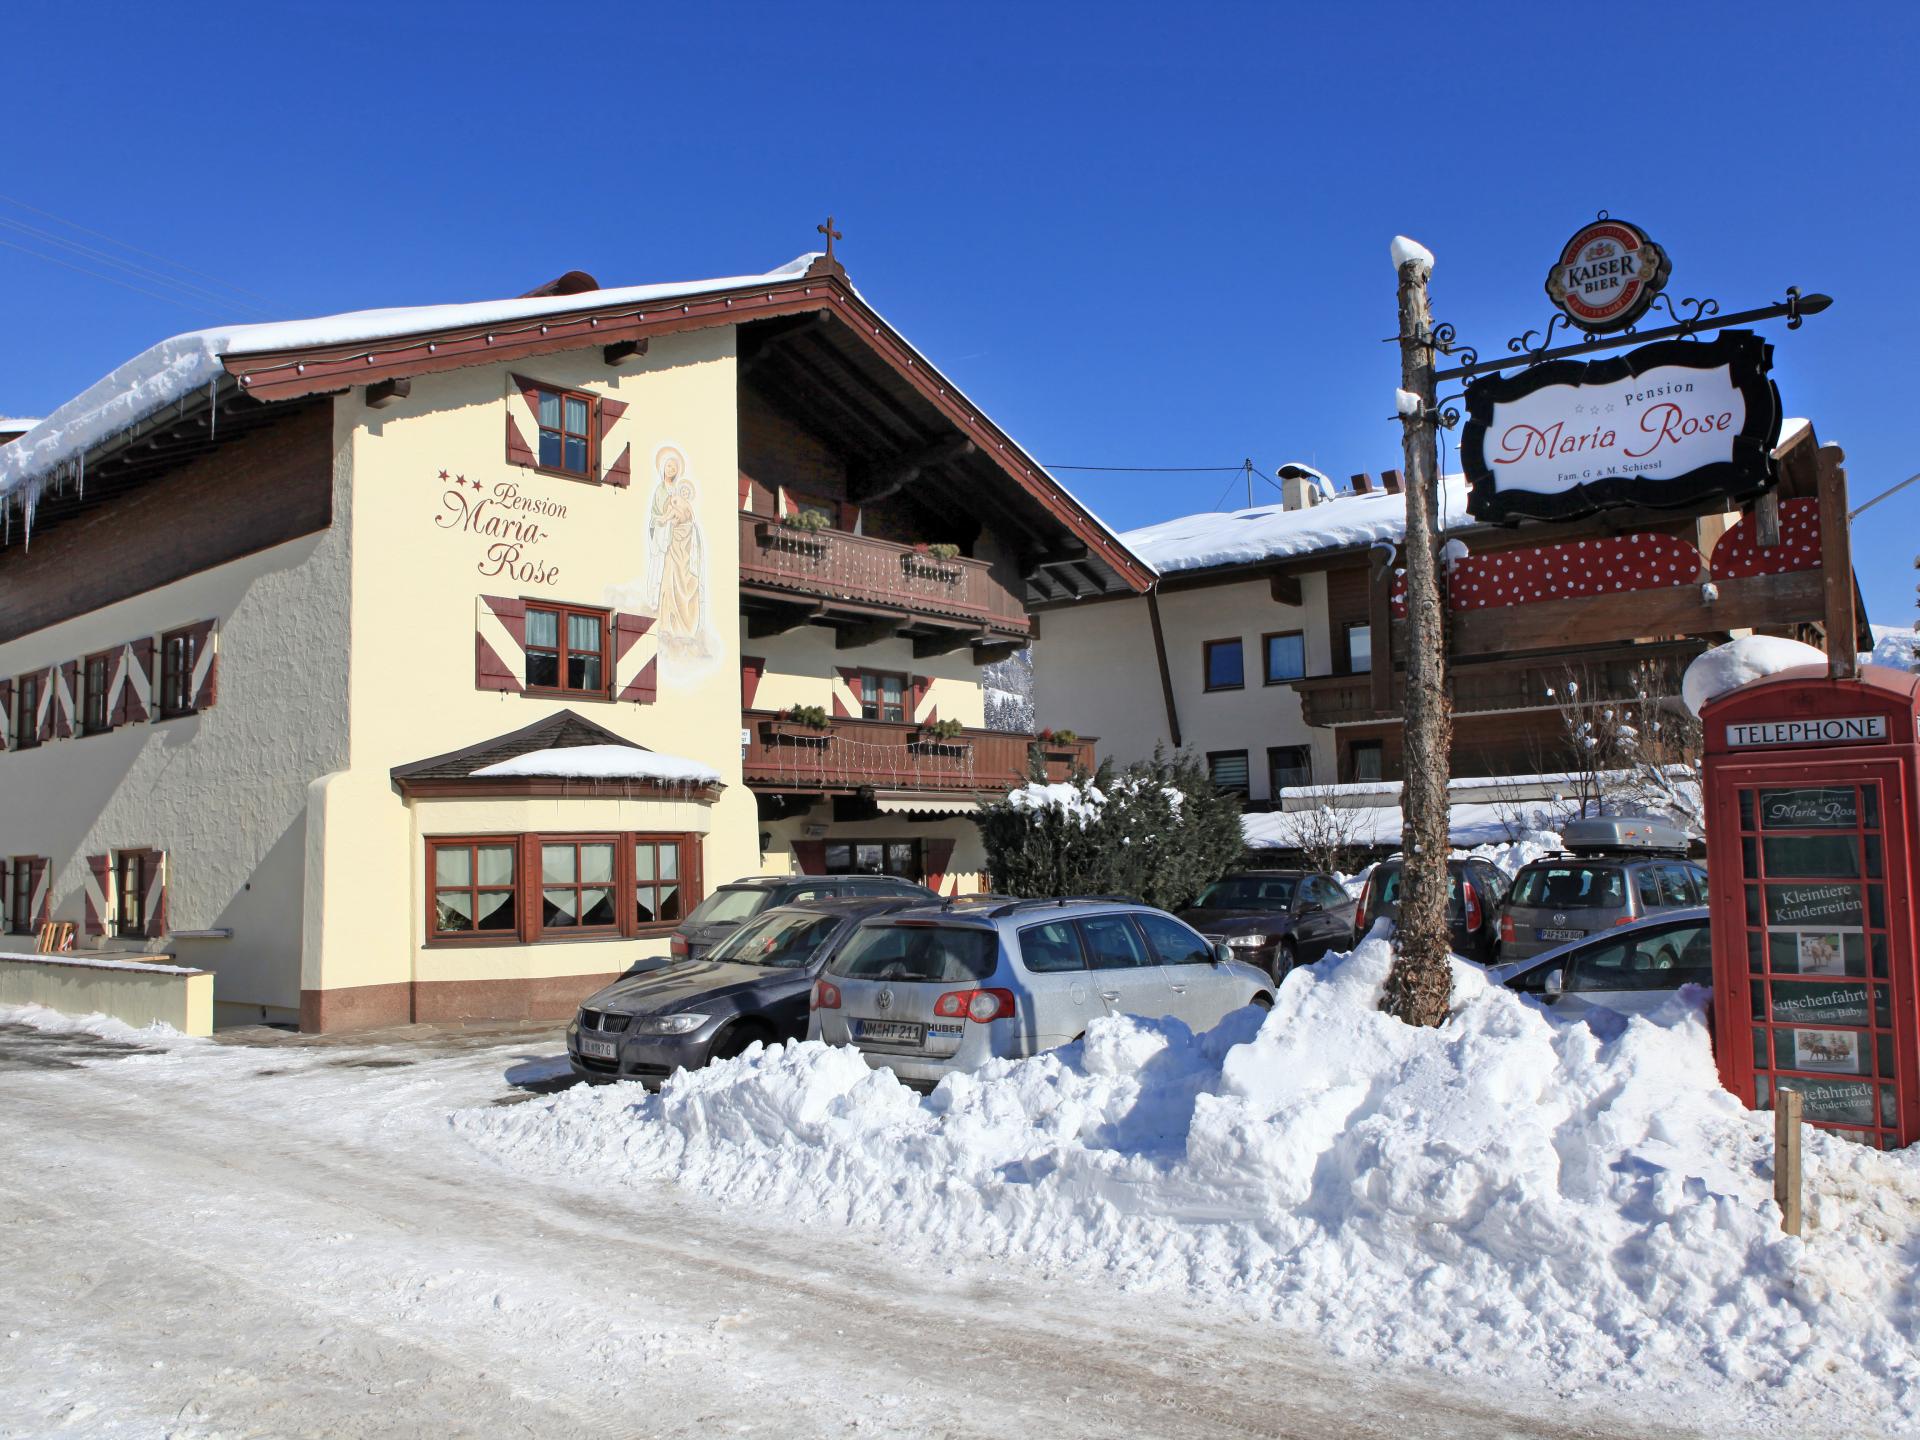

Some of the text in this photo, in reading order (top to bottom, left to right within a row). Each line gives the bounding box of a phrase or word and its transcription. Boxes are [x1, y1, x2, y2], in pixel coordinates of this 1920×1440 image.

[1568, 255, 1635, 288] KAISER
[1585, 276, 1619, 294] BIER
[1625, 382, 1694, 406] Pension
[1493, 402, 1732, 464] Maria Rose
[1622, 460, 1662, 473] Schiessl
[493, 482, 567, 519] Pension
[477, 543, 560, 585] Rose
[1734, 718, 1880, 744] TELEPHONE
[1769, 804, 1817, 818] Maria
[1781, 885, 1851, 905] Kleintiere
[1775, 899, 1863, 922] Kinderreiten
[1838, 1007, 1862, 1018] Baby
[863, 1022, 920, 1039] NM HT 211
[928, 1023, 963, 1034] HUBER
